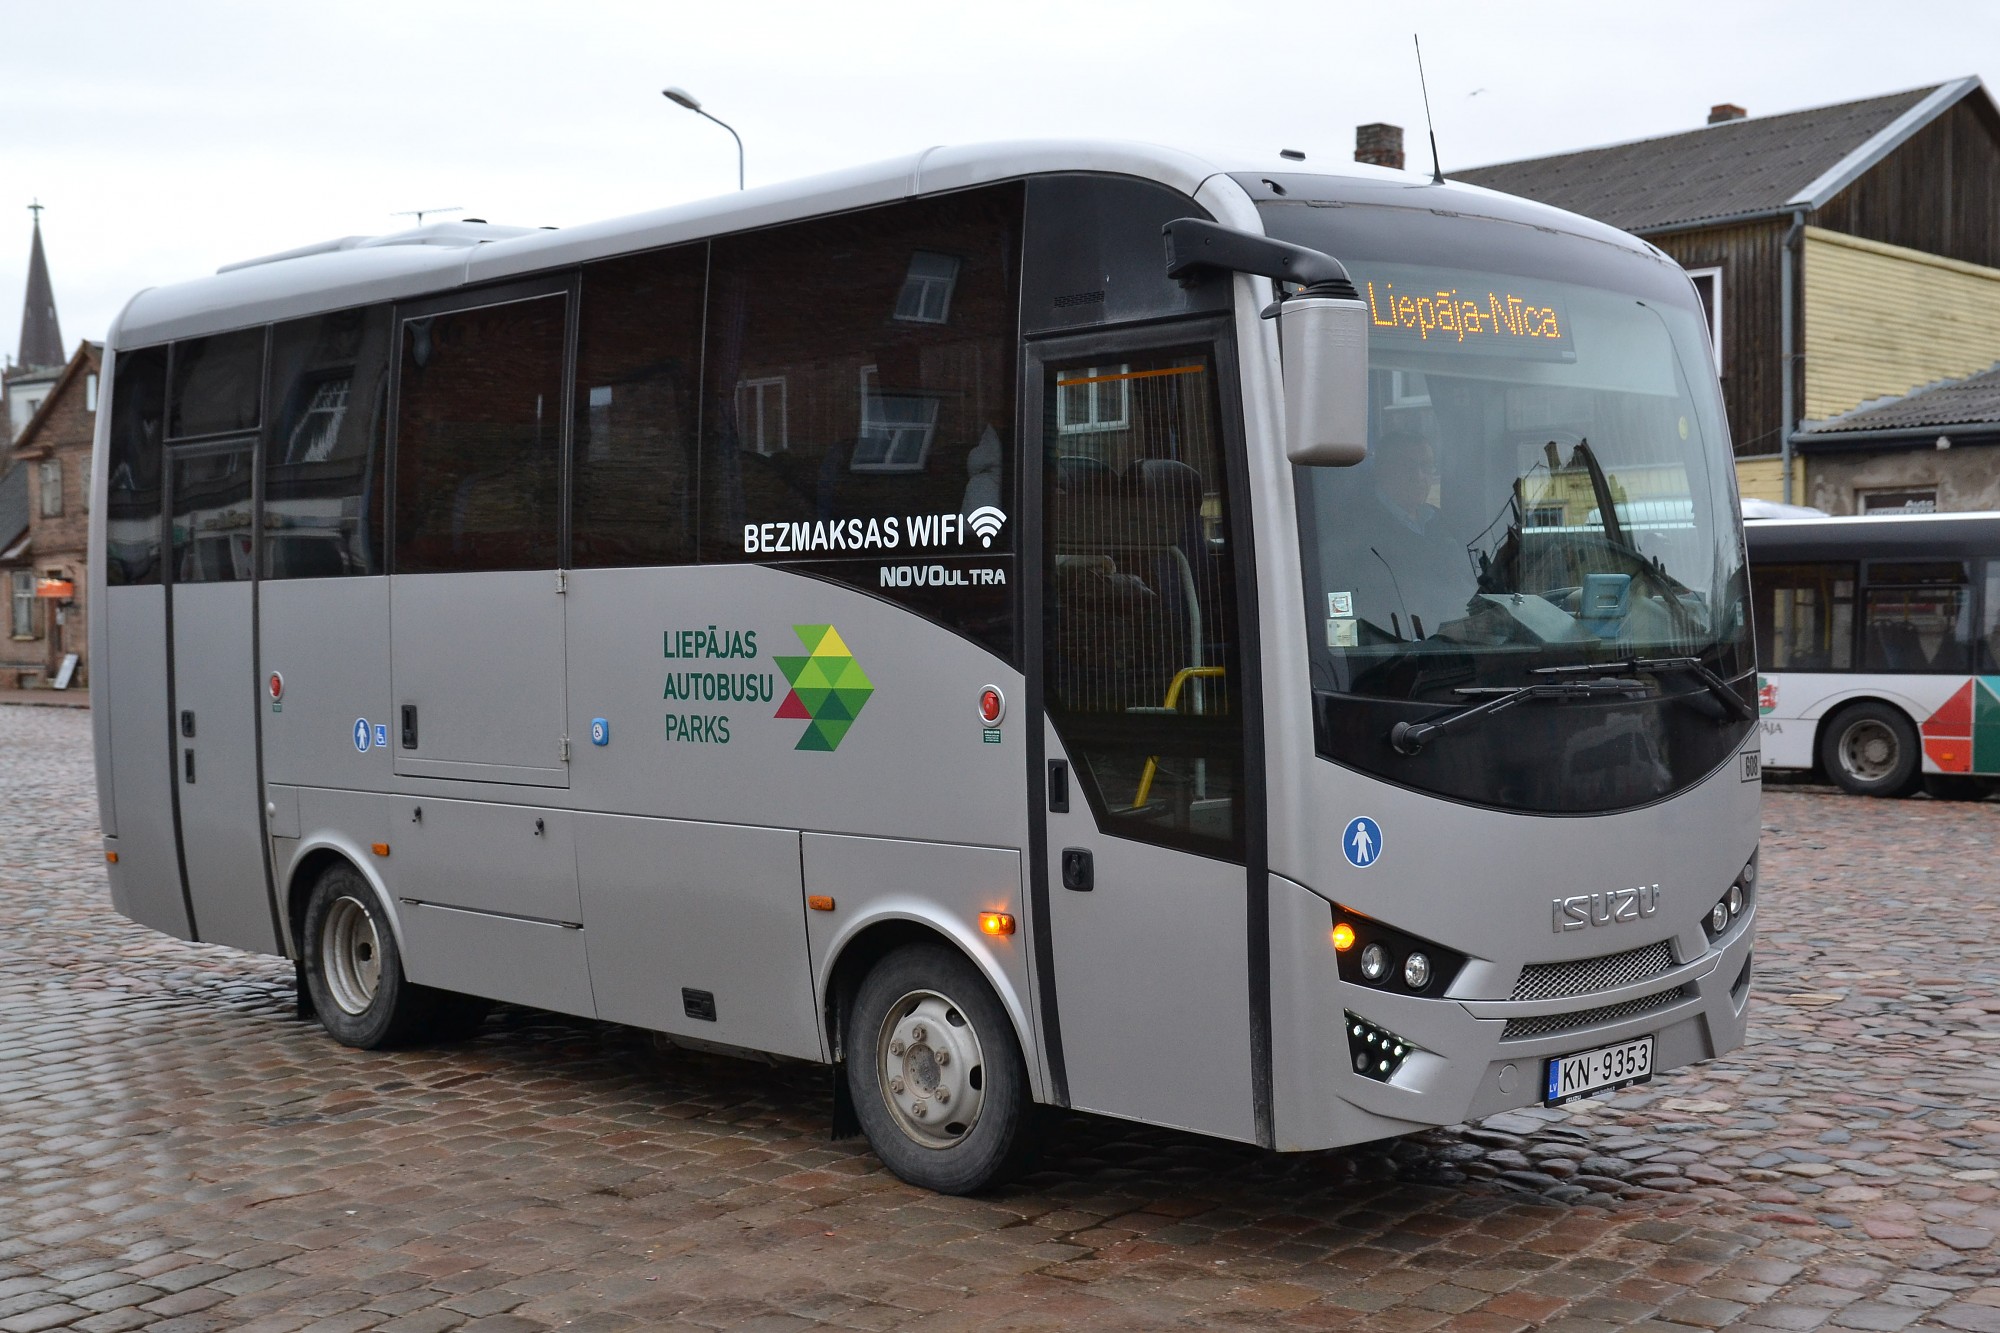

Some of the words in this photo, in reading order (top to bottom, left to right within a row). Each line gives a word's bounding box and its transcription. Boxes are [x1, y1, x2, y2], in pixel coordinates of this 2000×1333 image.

[1367, 281, 1562, 343] Liepāja-Nīca
[743, 516, 900, 553] BEZMAKSAS
[906, 512, 964, 547] WIFI
[663, 624, 758, 659] LIEPĀJAS
[663, 672, 774, 702] AUTOBUSU
[665, 713, 730, 744] PARKS
[1552, 883, 1660, 933] ISUZU
[1562, 1043, 1649, 1092] KN-9353
[1549, 1082, 1558, 1093] LV
